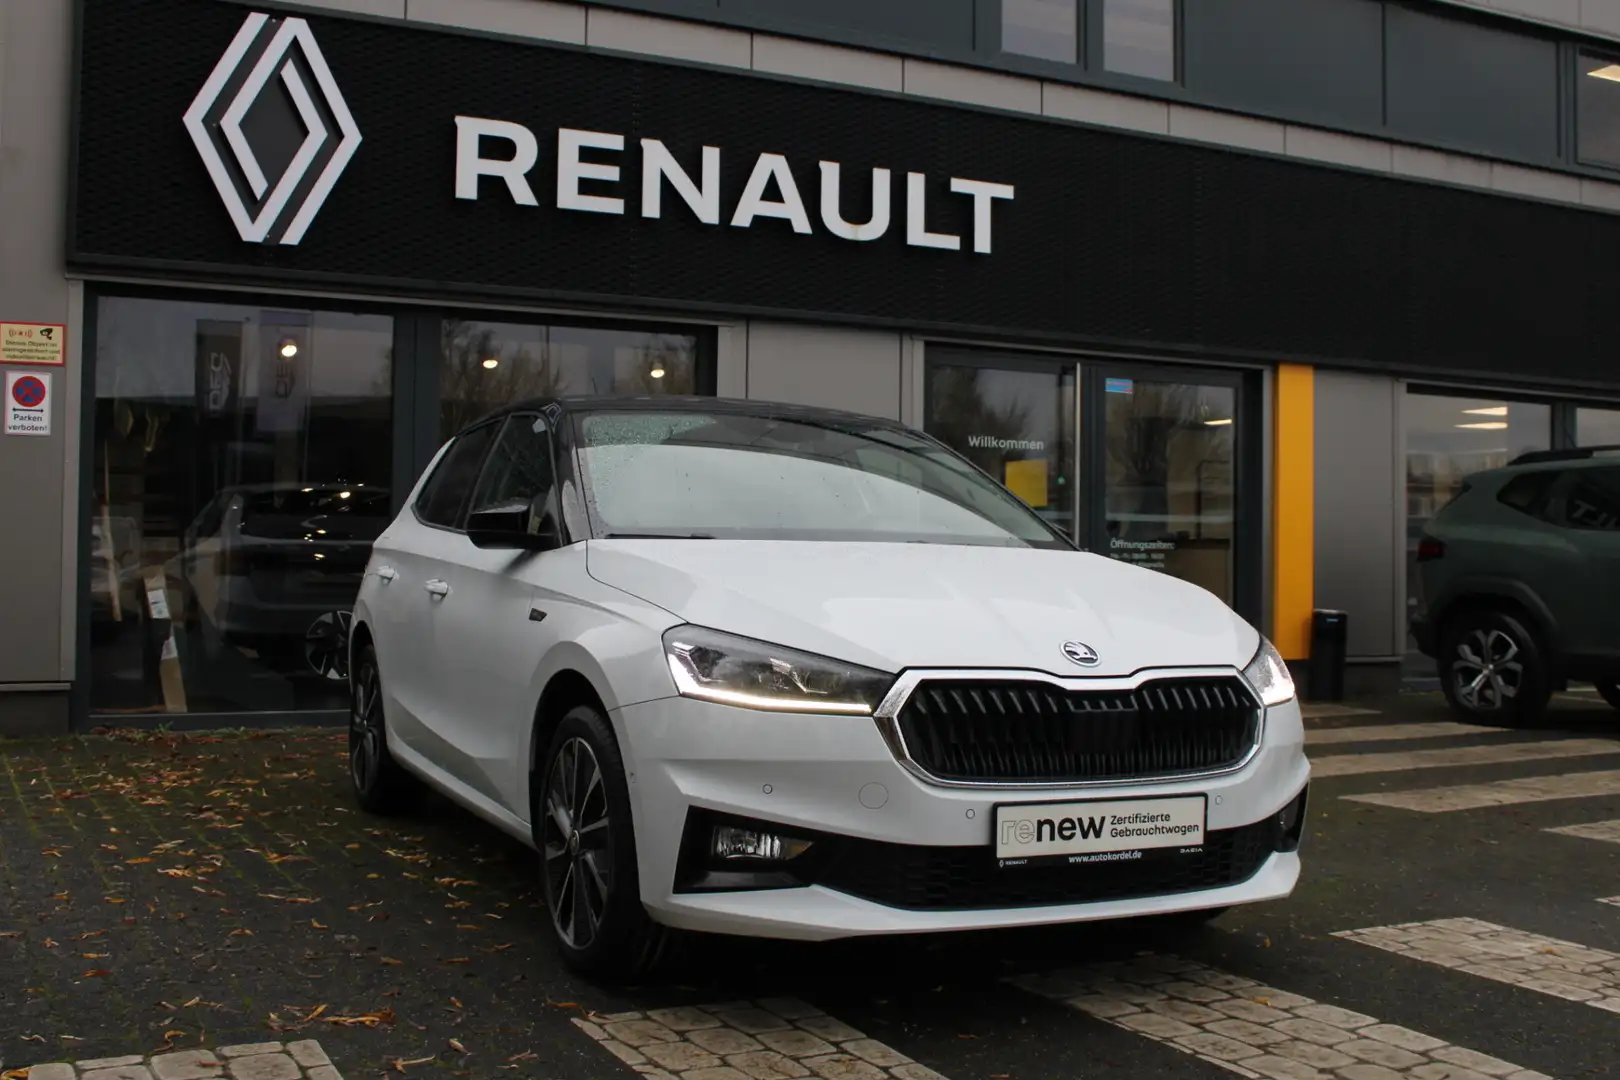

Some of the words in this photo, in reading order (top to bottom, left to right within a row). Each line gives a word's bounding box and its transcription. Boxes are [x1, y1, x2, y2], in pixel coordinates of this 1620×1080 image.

[454, 115, 1015, 255] RENAULT
[13, 413, 43, 422] Parken
[8, 423, 47, 432] verboten!
[968, 435, 1044, 450] Willkommen
[1110, 812, 1171, 826] Zertifizierte
[1001, 815, 1106, 845] renew
[1110, 823, 1200, 838] Gebrauchtwagen
[1068, 850, 1143, 864] www.autokordel.de
